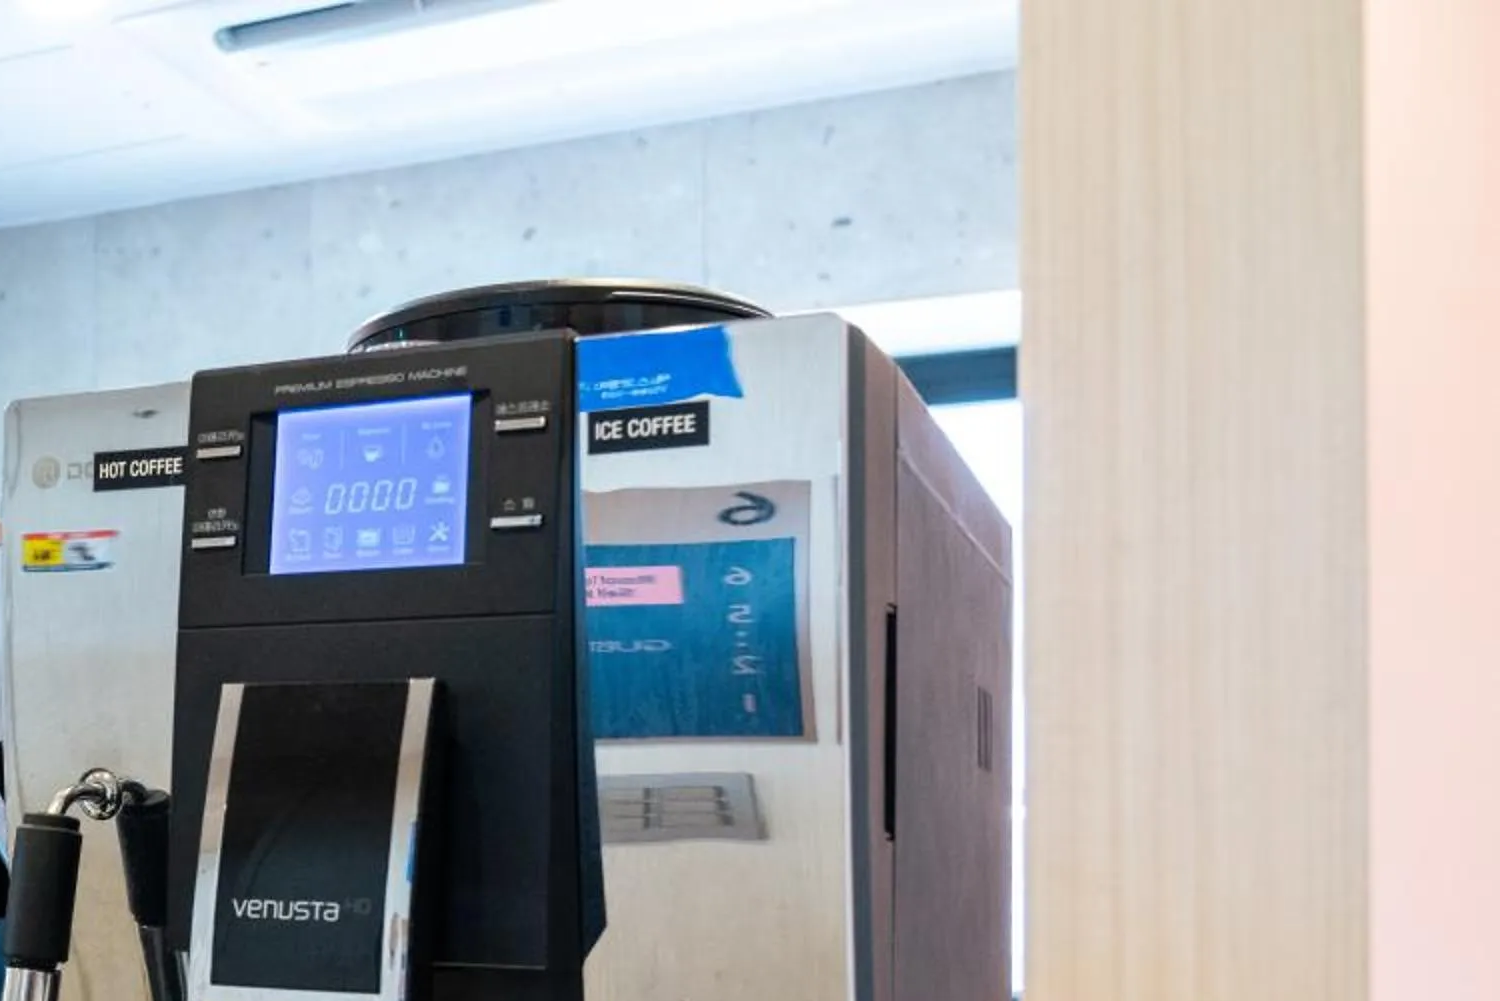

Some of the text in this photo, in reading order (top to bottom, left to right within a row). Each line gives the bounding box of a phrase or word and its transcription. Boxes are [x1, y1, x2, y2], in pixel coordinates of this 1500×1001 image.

[595, 413, 697, 440] ICE COFFEE
[99, 457, 183, 479] HOT COFFEE
[324, 477, 418, 515] 0000
